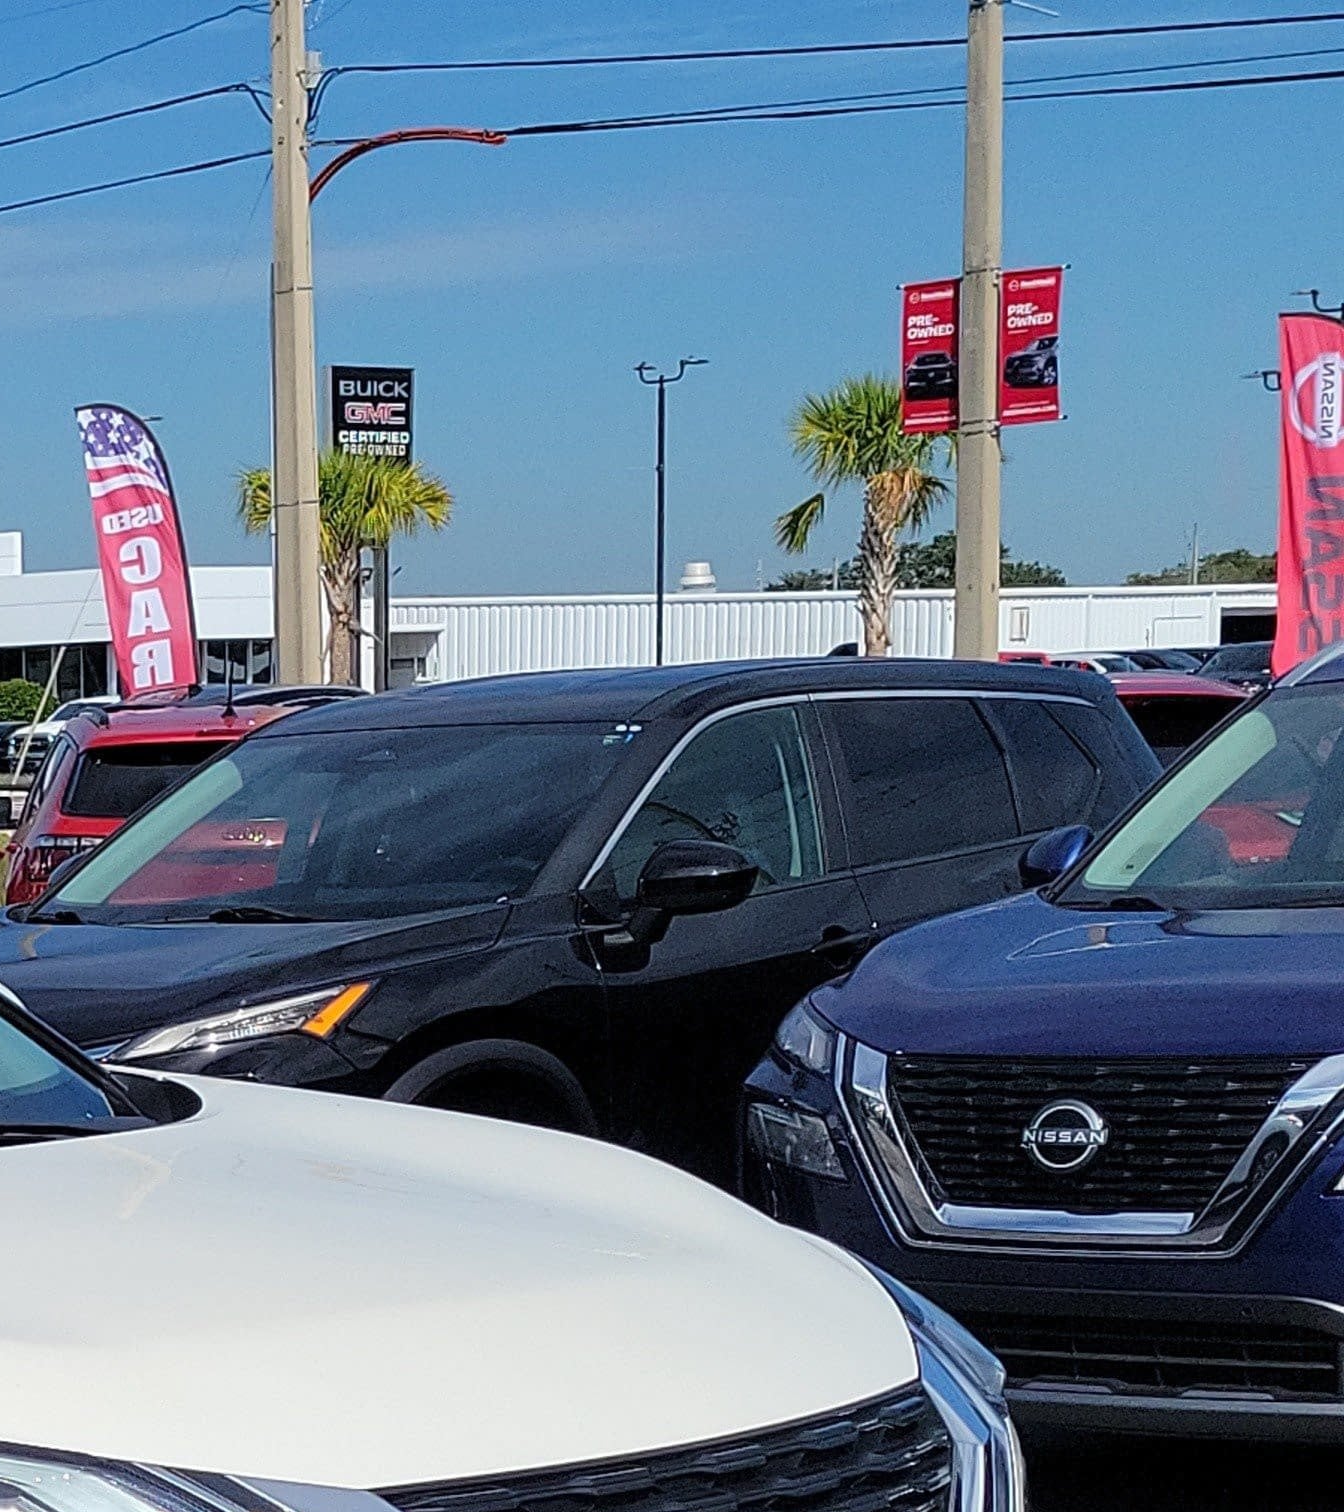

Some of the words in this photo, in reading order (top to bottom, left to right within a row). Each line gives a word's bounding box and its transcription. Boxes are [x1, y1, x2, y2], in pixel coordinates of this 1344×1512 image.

[1006, 302, 1039, 316] PRE-
[907, 313, 940, 328] PRE-
[1007, 311, 1054, 328] OWNED
[907, 323, 954, 340] OWNED
[338, 380, 409, 398] BUICK
[344, 402, 406, 425] GMC
[338, 430, 410, 444] CERTIFIED
[1022, 1130, 1105, 1143] NISSAN
